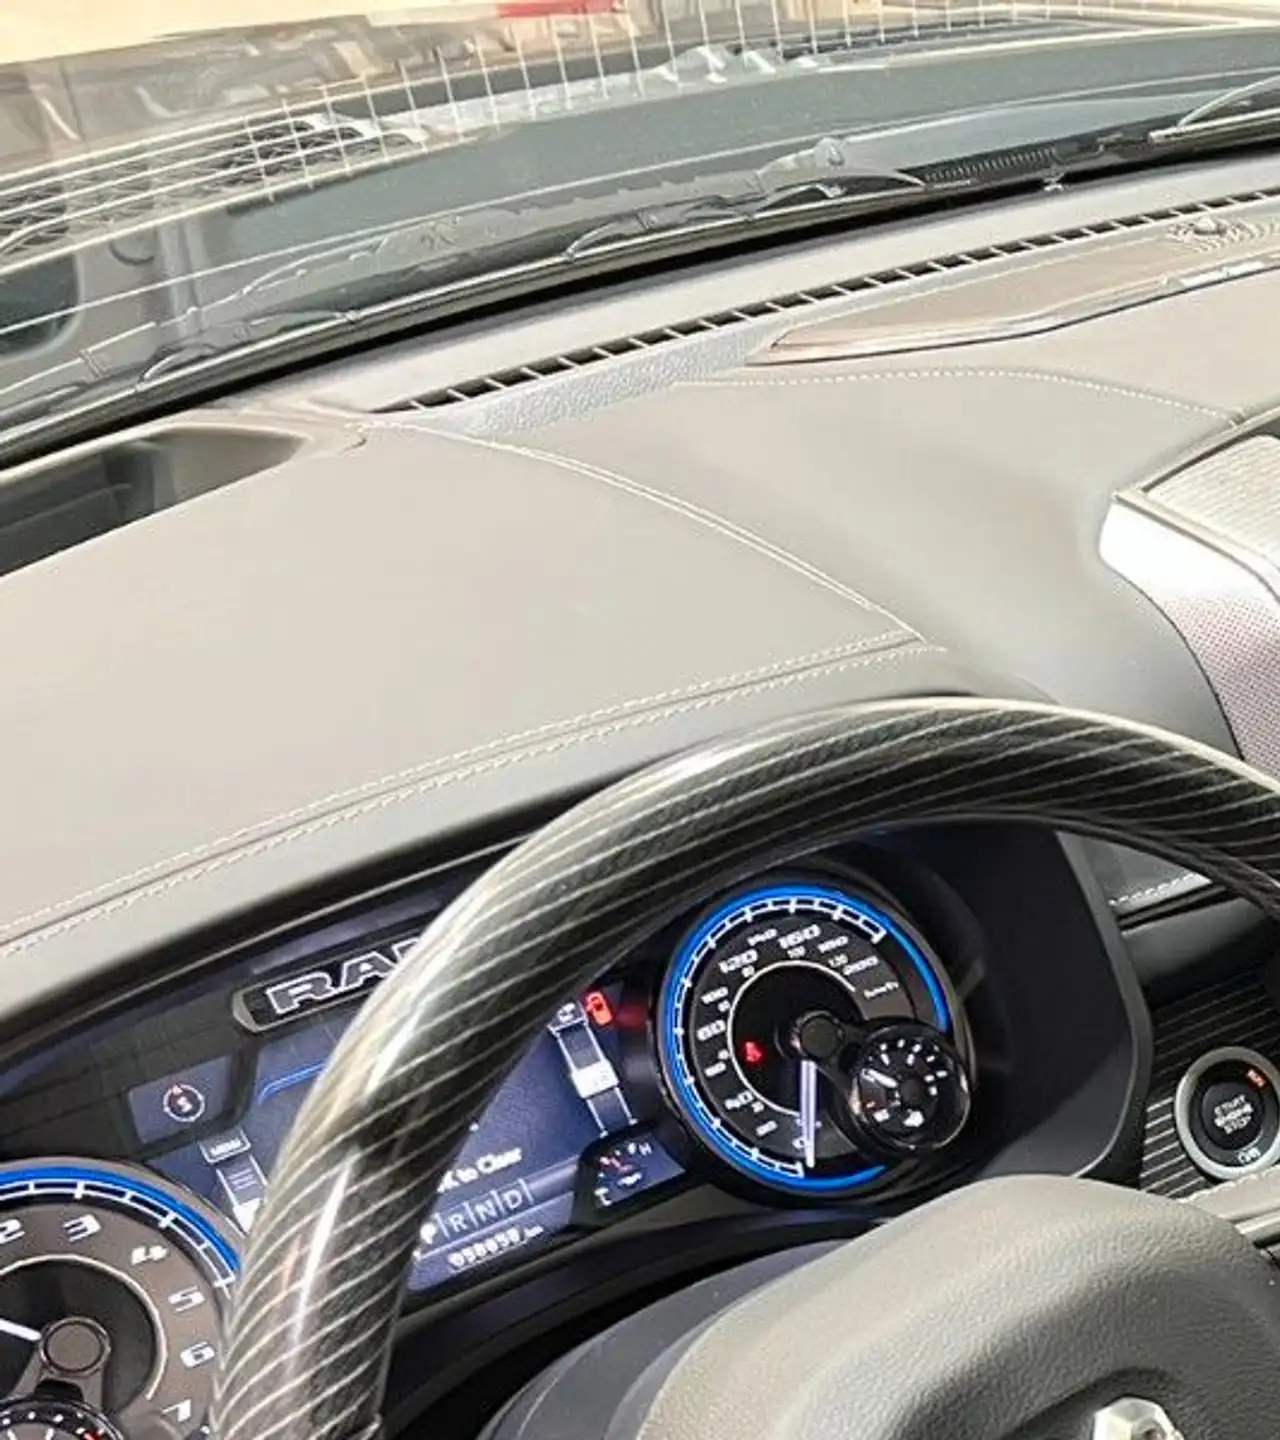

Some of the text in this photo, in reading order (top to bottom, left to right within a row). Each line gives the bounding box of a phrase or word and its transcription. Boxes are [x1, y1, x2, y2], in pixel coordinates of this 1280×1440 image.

[777, 925, 820, 948] 160
[719, 950, 758, 973] 120
[450, 1213, 468, 1233] R
[479, 1201, 498, 1222] N
[503, 1188, 523, 1210] D
[62, 1214, 101, 1242] 3
[130, 1246, 170, 1266] 4
[168, 1286, 205, 1313] 5
[180, 1341, 216, 1368] 6
[162, 1399, 193, 1423] 7
